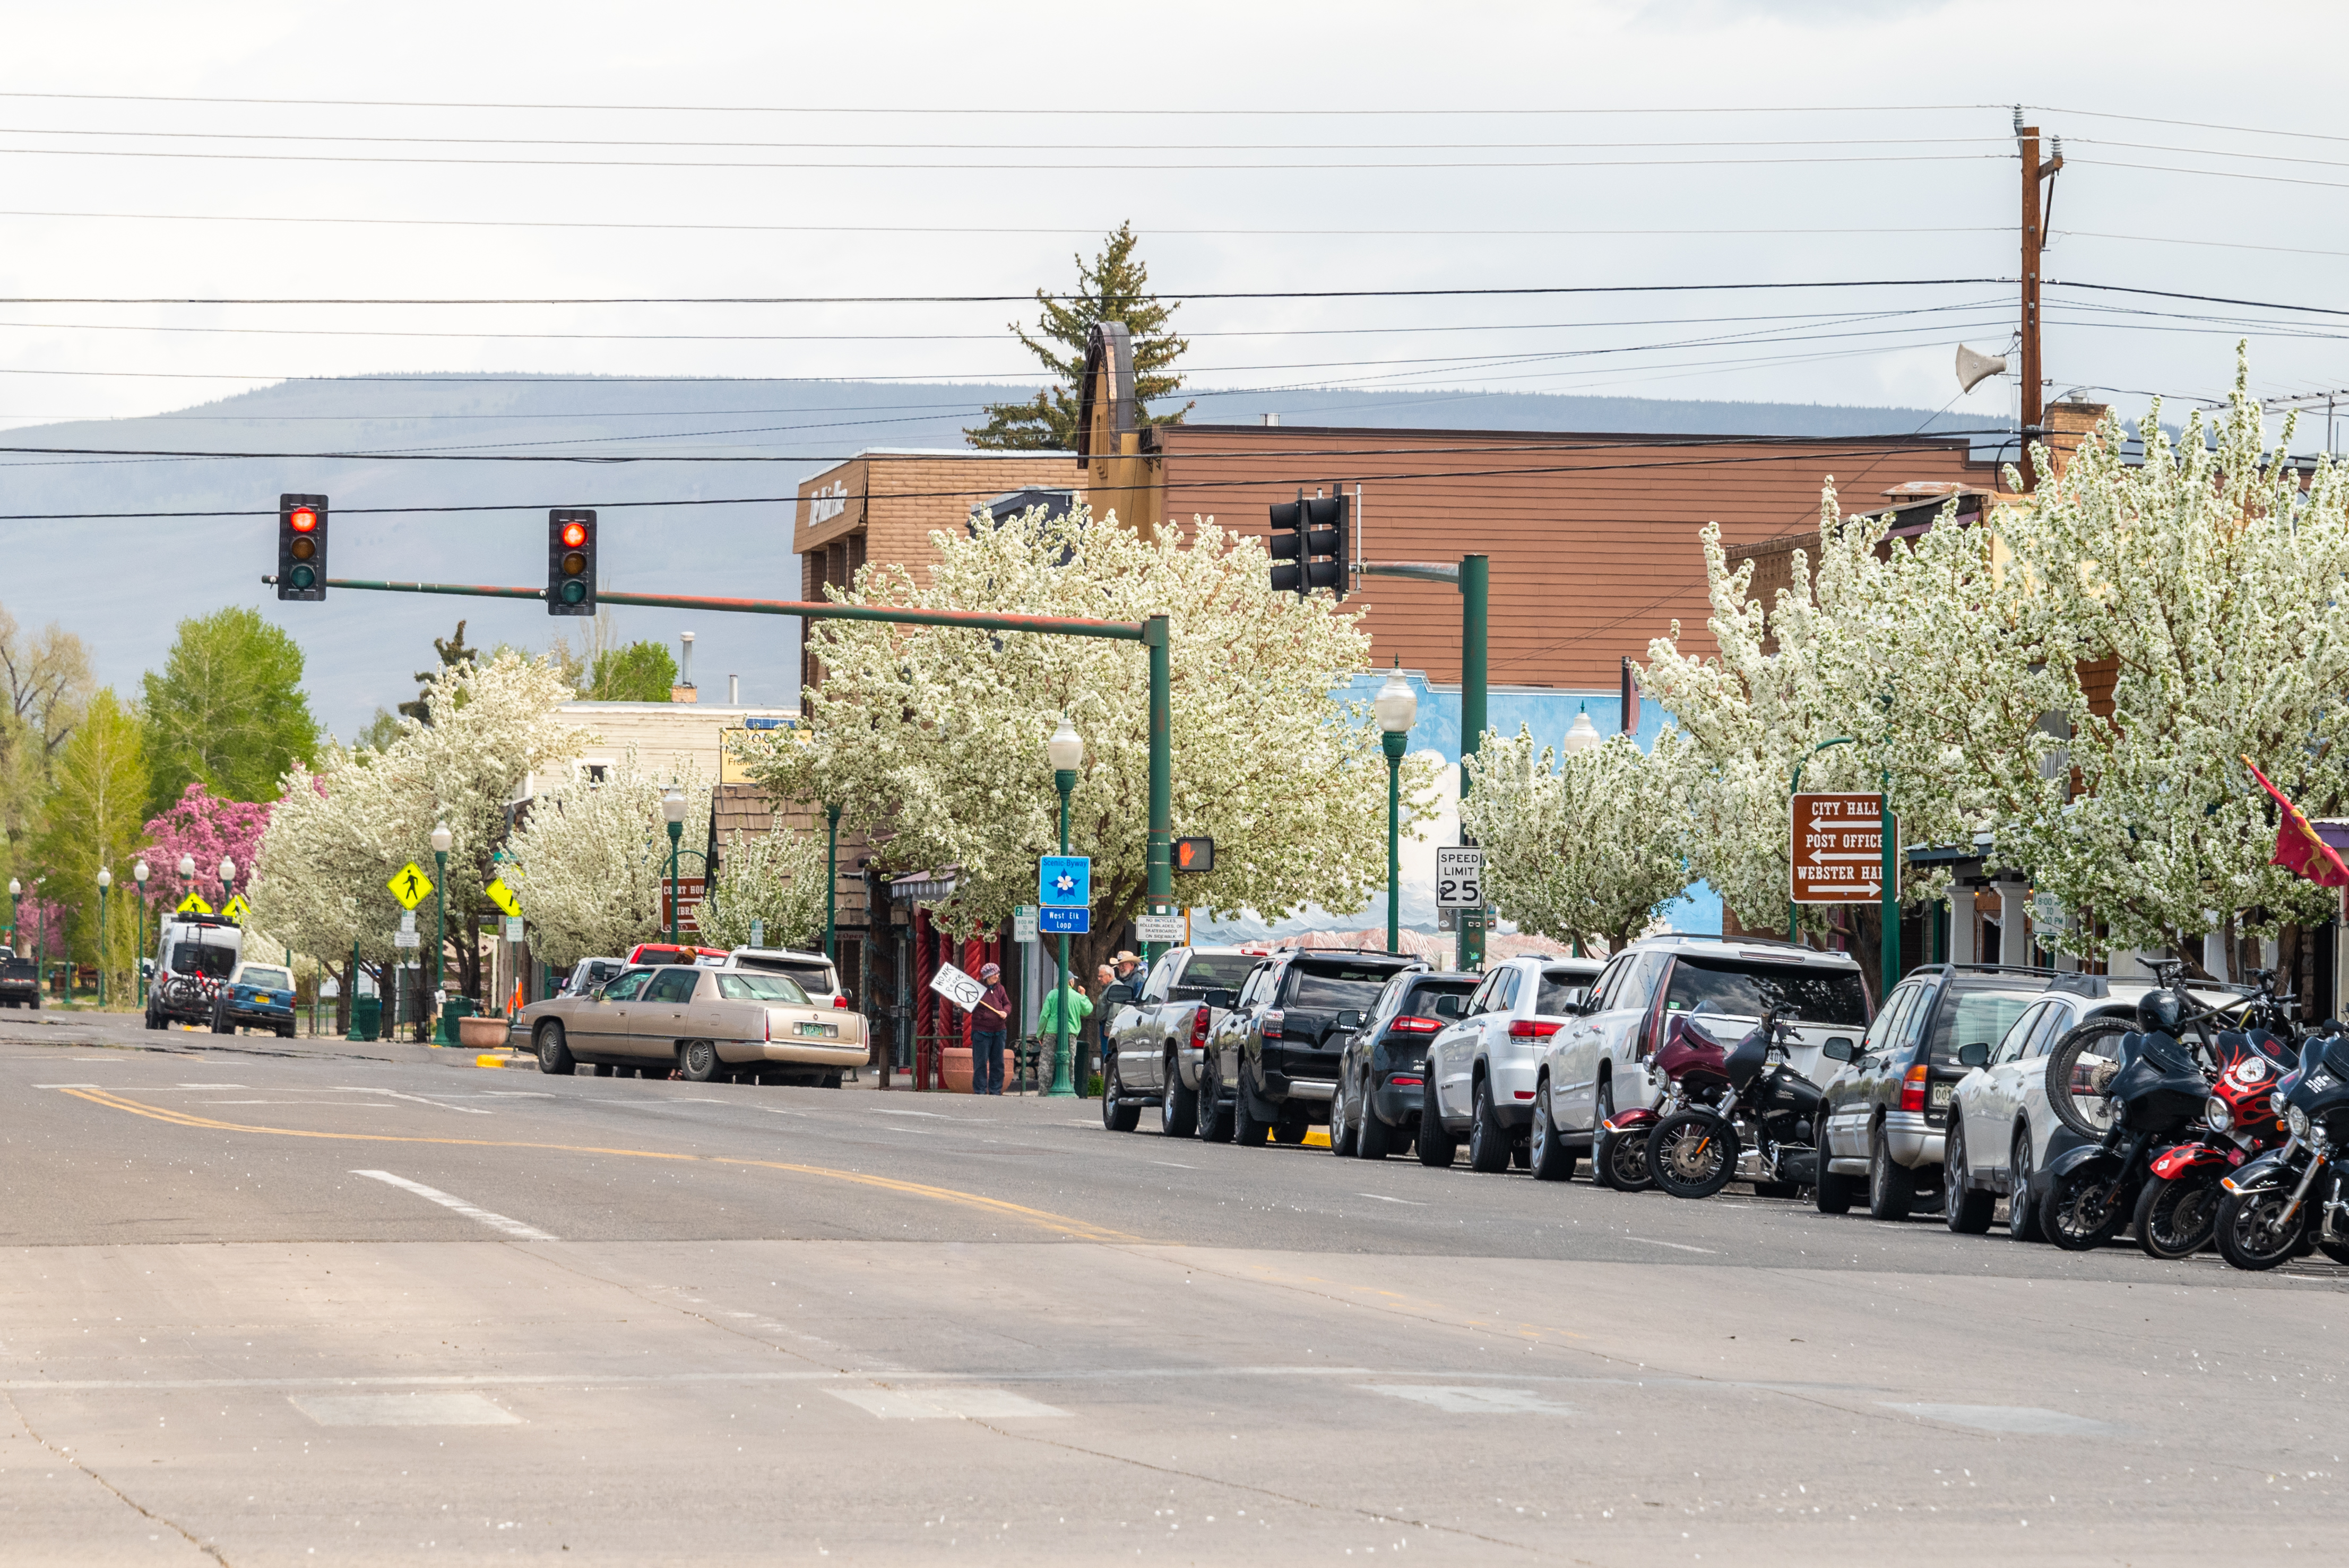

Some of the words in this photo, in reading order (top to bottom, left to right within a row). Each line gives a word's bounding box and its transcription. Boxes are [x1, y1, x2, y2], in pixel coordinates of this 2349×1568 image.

[1812, 802, 1841, 816] CITY
[1846, 802, 1879, 816] HALL
[1806, 834, 1836, 848] POST
[1066, 859, 1087, 868] Byway
[1441, 854, 1479, 863] SPEED
[1444, 867, 1474, 876] LIMIT
[1797, 866, 1855, 880] WEBSTER
[1861, 866, 1882, 880] HA
[663, 886, 687, 895] CORT
[690, 885, 704, 894] HOU
[1439, 880, 1479, 902] 25
[935, 965, 954, 986] HONK
[1766, 1053, 1783, 1062] 408
